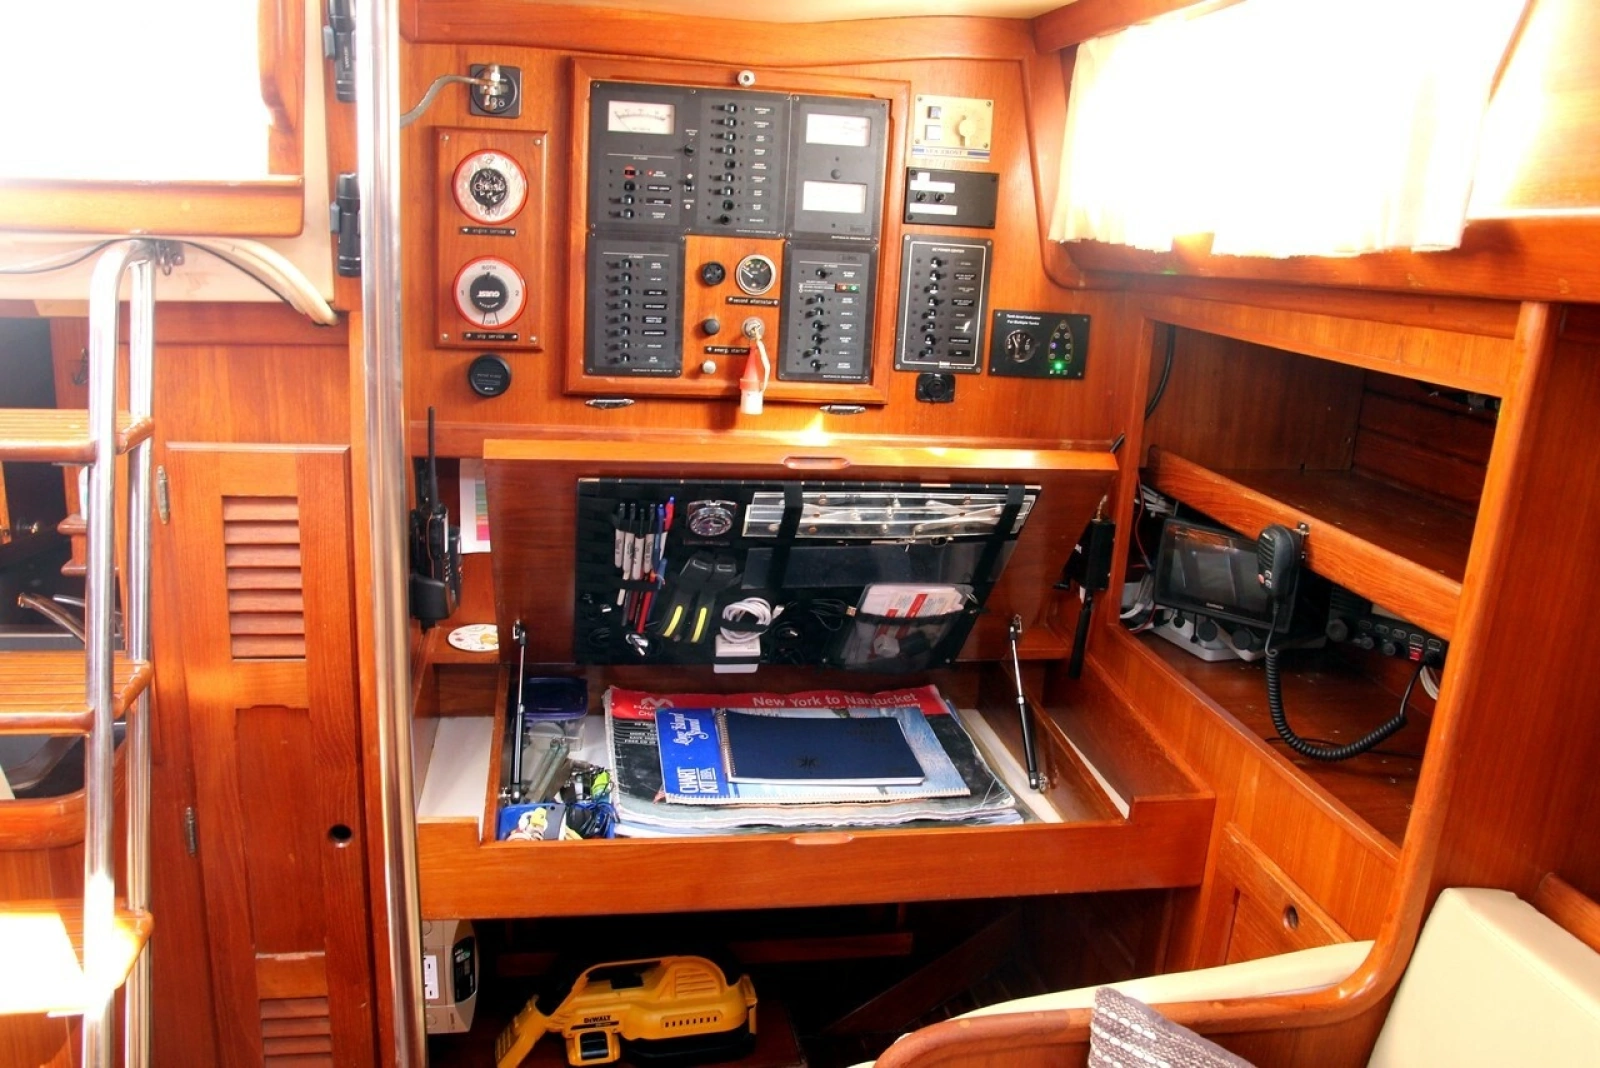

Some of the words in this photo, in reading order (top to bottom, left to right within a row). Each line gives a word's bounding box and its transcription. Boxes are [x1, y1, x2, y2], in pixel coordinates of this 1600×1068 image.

[753, 697, 785, 707] New
[789, 697, 821, 707] York
[826, 695, 840, 706] to
[844, 693, 918, 706] Nantucket
[677, 766, 699, 794] CHART
[699, 781, 719, 794] KIT
